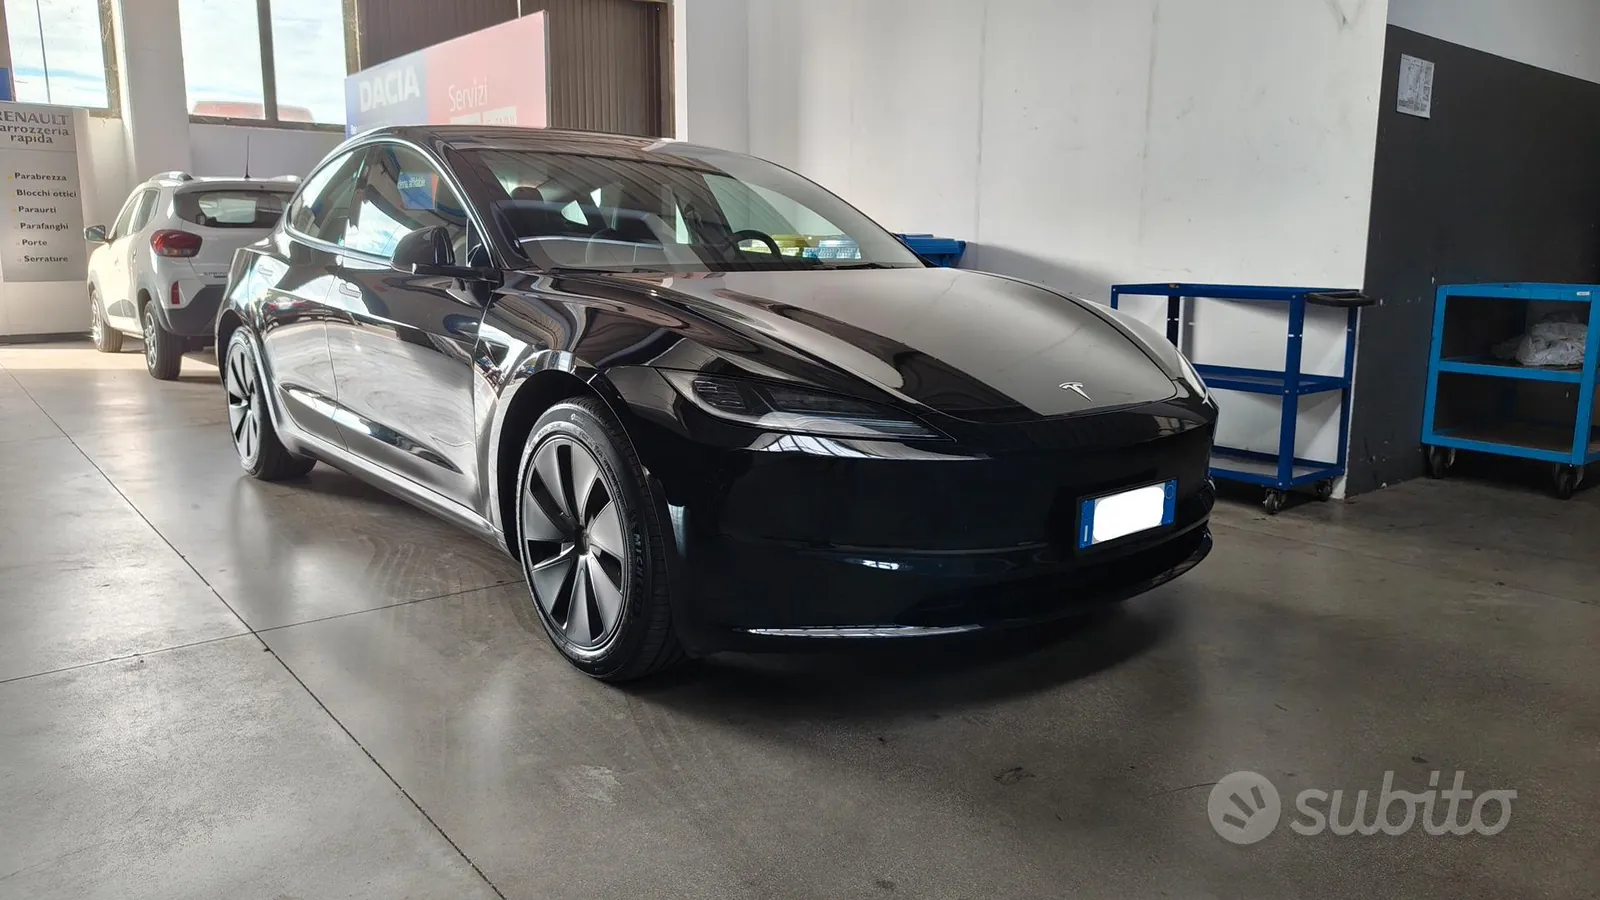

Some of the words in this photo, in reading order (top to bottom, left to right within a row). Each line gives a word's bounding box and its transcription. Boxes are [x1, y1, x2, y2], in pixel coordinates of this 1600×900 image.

[359, 65, 420, 113] DACIA
[449, 76, 488, 112] Servizi
[0, 124, 70, 136] arrozzeria
[10, 133, 54, 145] rapida
[14, 172, 68, 181] Parabrezza
[16, 189, 51, 197] Blocchi
[52, 190, 77, 198] ottici
[18, 205, 57, 214] Paraurti
[20, 222, 69, 232] Parafanghi
[23, 255, 69, 263] Serrature
